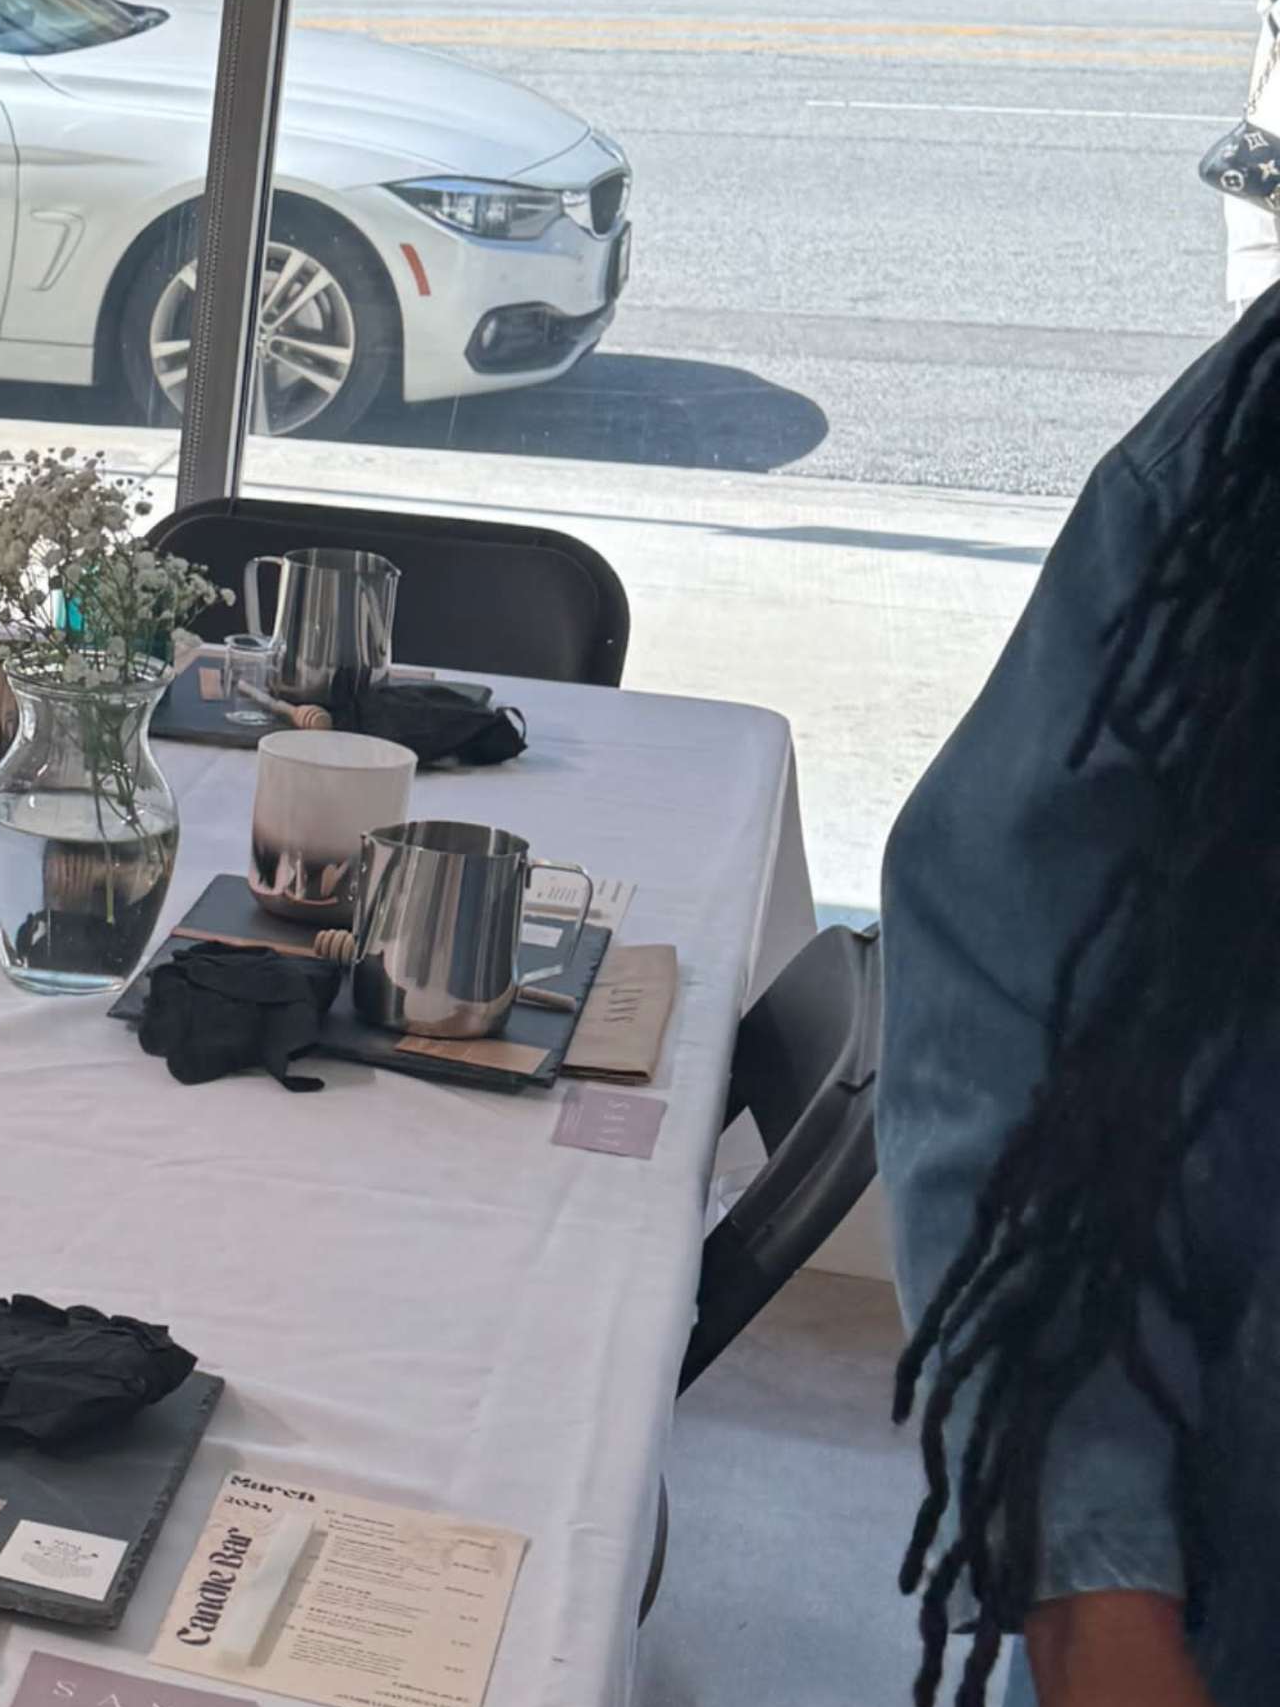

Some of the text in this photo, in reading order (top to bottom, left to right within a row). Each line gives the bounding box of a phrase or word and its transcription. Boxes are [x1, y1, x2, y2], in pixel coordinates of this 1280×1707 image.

[229, 1474, 318, 1503] March
[176, 1526, 254, 1648] Candle Bar
